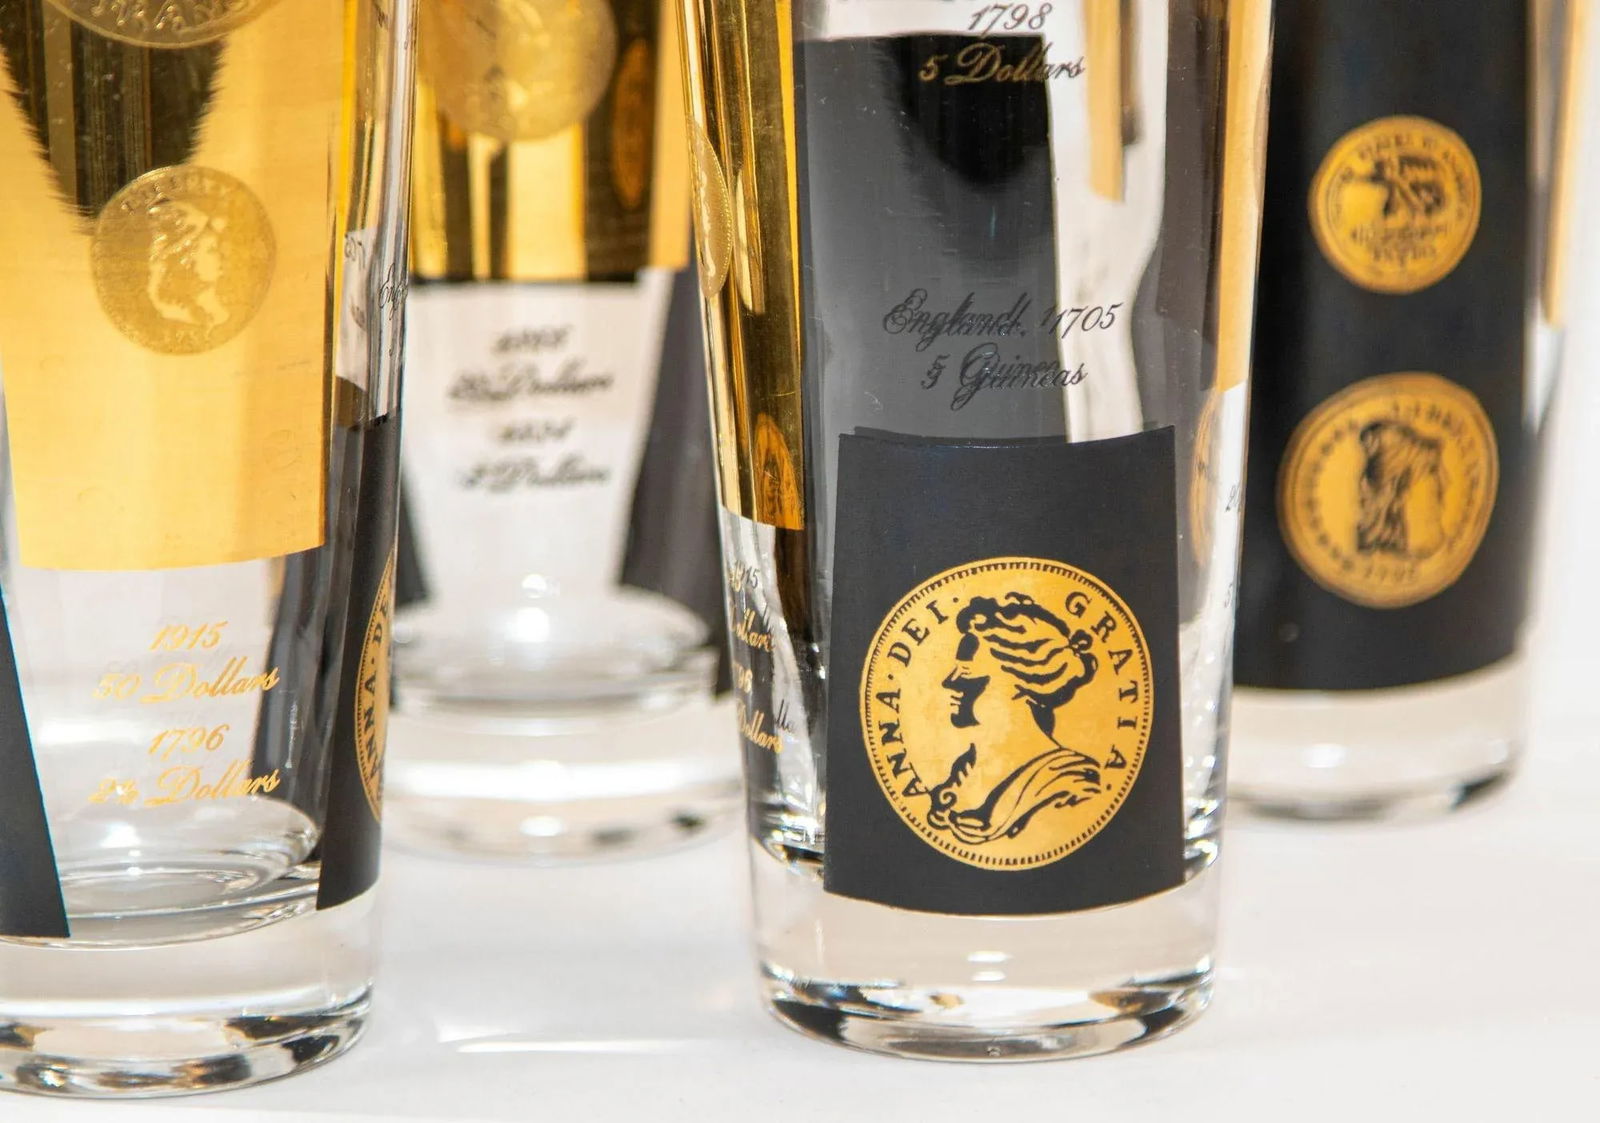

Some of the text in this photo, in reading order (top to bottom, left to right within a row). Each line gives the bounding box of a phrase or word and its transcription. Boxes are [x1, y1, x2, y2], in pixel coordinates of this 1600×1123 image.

[968, 2, 1053, 38] 1798
[918, 42, 1086, 85] 5 Dollars
[921, 342, 1088, 411] 5 Guineas
[149, 620, 228, 651] 1915
[92, 656, 280, 704] 50 Dollars
[148, 723, 229, 761] 1796
[144, 758, 280, 808] Dollars
